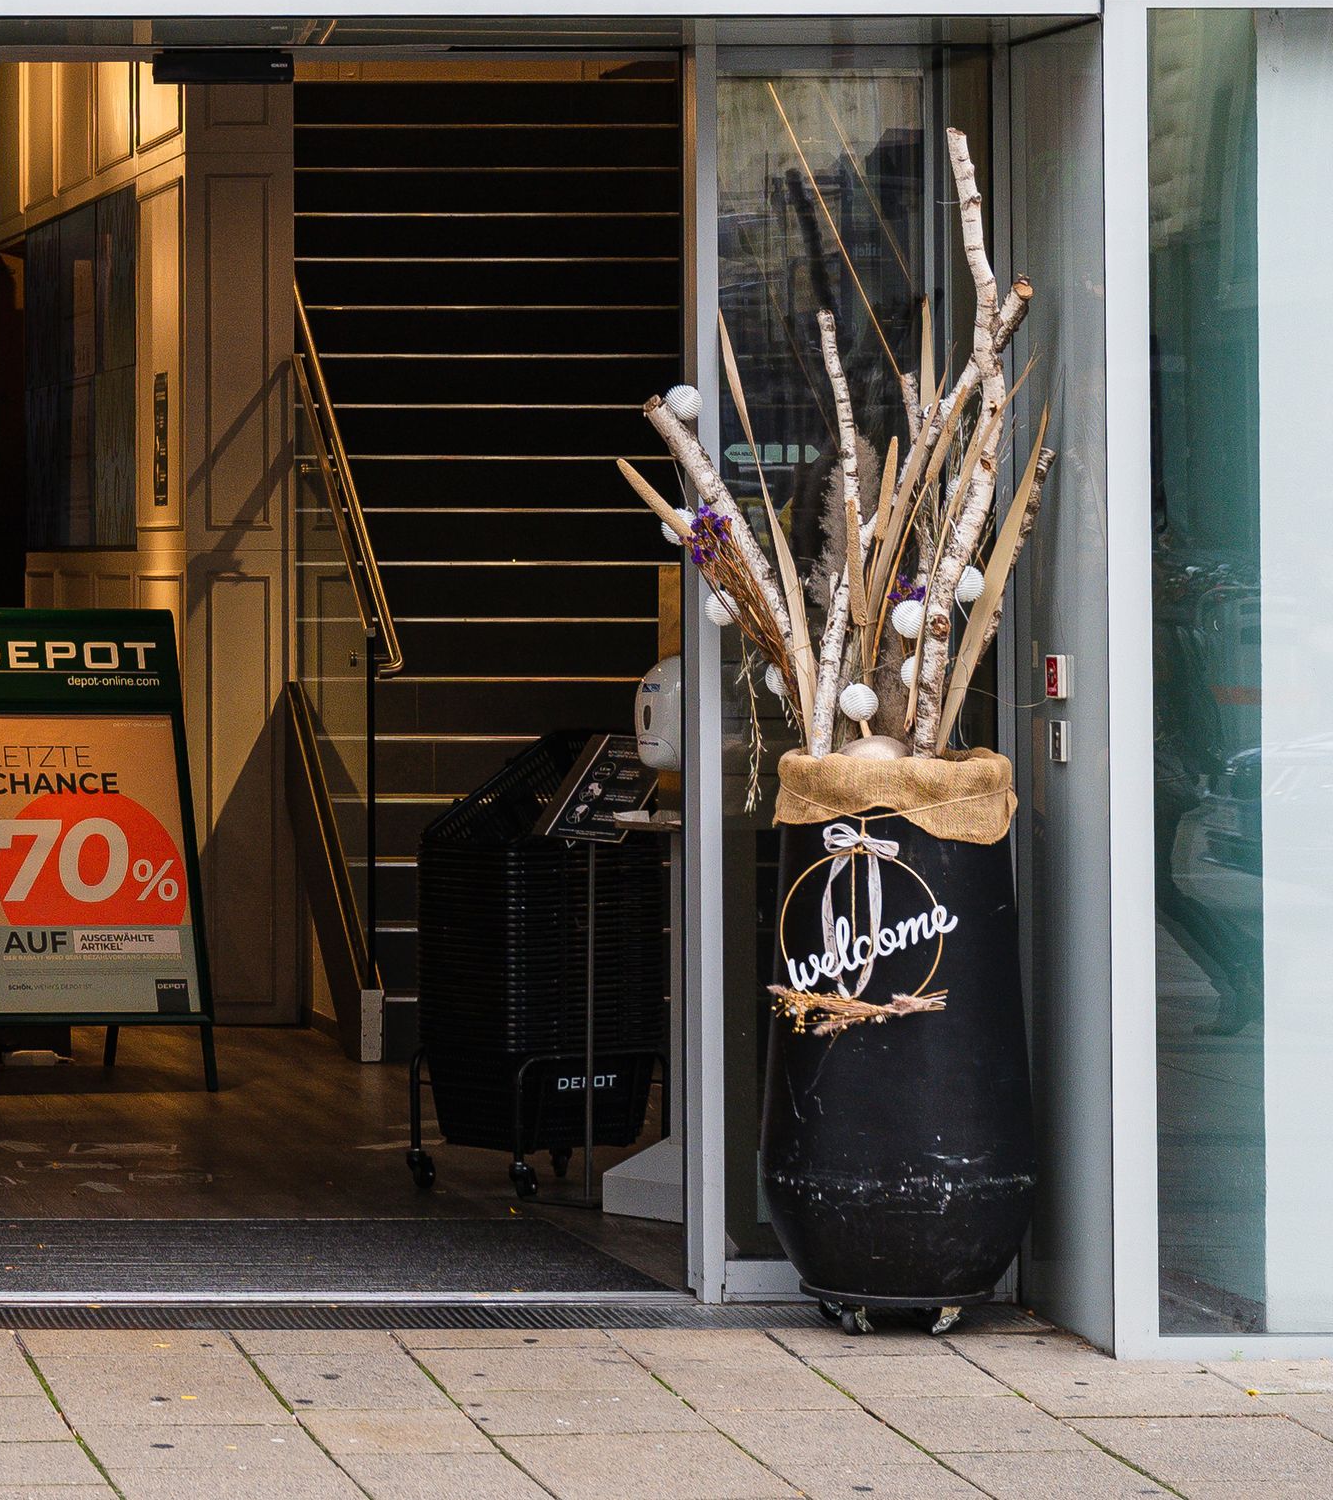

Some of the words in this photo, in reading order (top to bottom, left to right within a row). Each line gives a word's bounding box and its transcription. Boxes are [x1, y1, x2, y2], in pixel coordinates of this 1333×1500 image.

[67, 675, 160, 688] depot-online.com
[4, 931, 67, 954] AUF
[80, 932, 155, 943] AUSGEWÄHLTE
[787, 904, 959, 992] welcome
